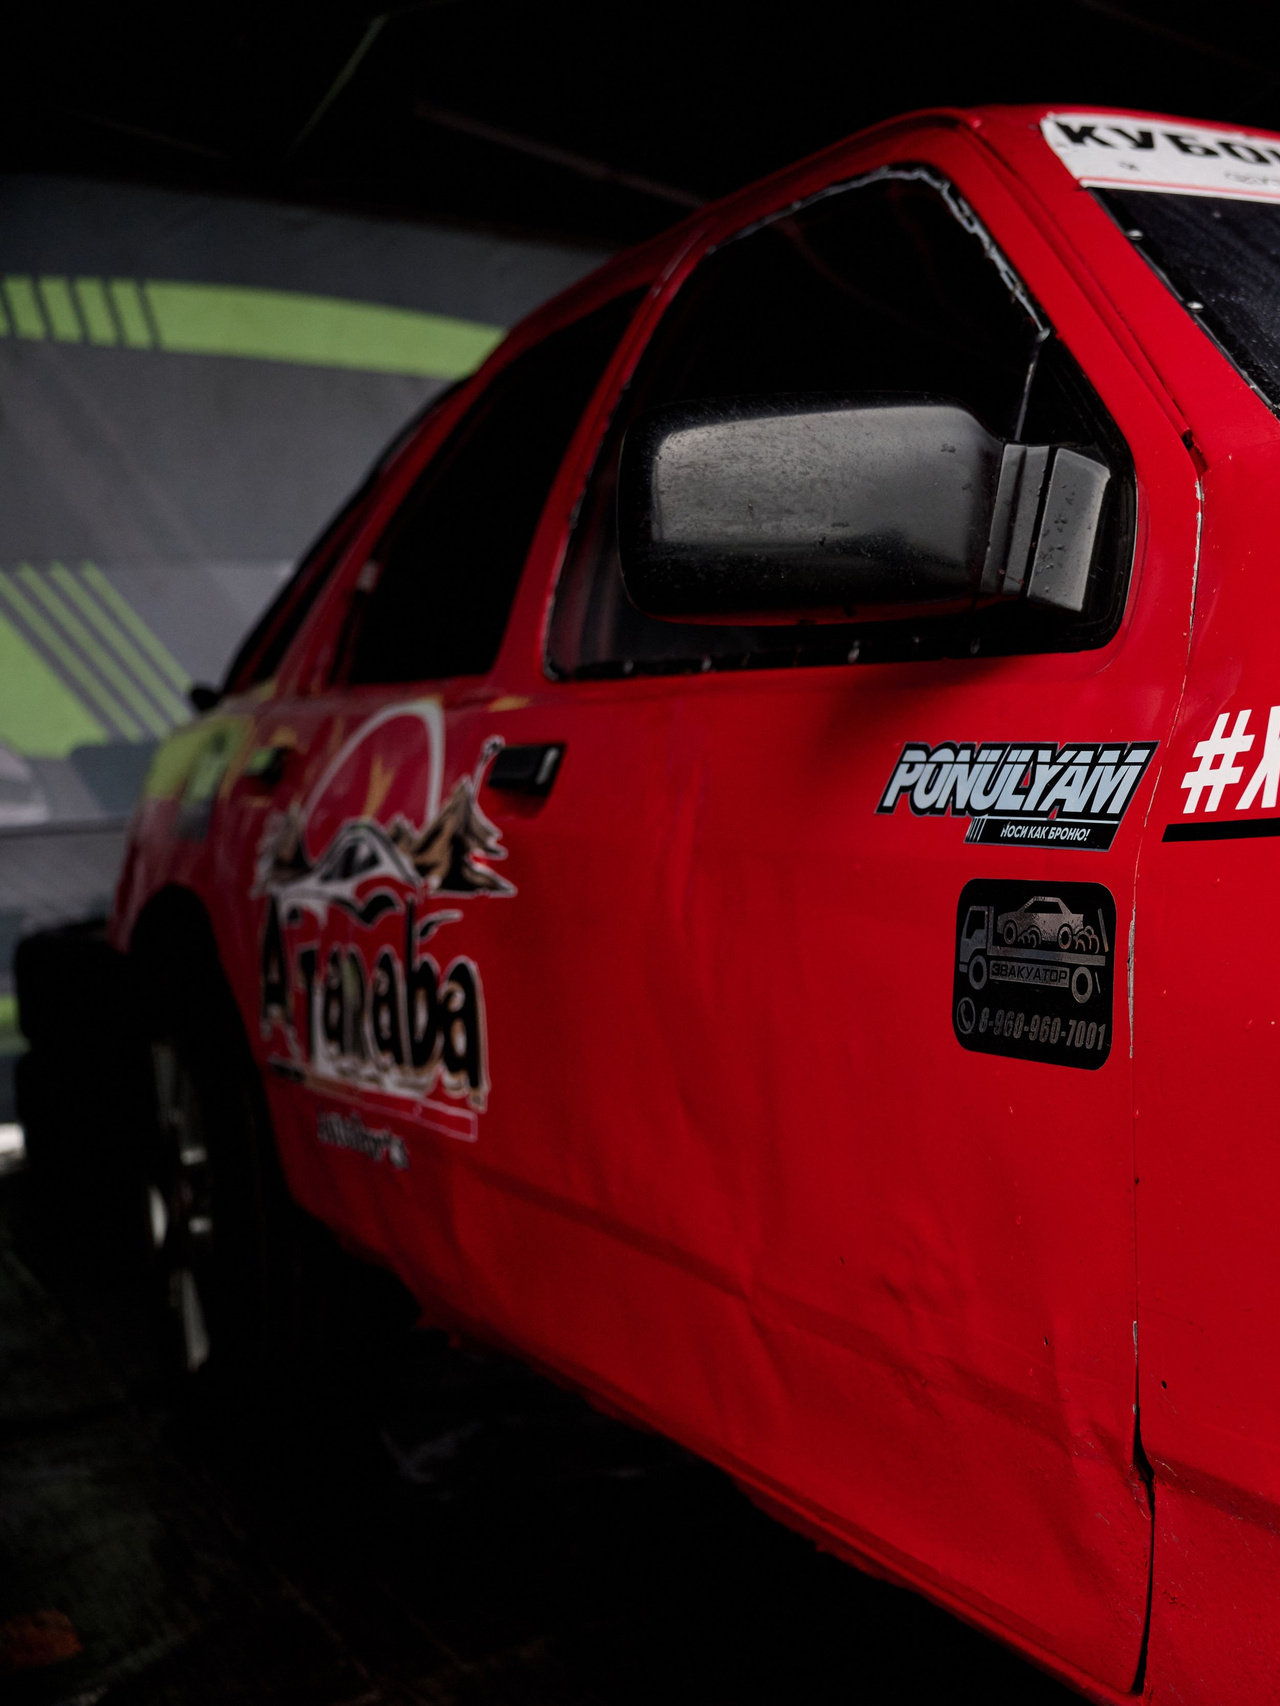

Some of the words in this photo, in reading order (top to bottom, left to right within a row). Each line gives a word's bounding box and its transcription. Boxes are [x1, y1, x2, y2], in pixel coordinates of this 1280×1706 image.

[882, 747, 1150, 815] PONULYAM
[1028, 826, 1049, 840] КАК
[1048, 826, 1091, 842] БРОНЮ!
[991, 964, 1068, 984] ЭВАКУАТОР
[978, 1006, 1107, 1051] 8-960-960-7001
